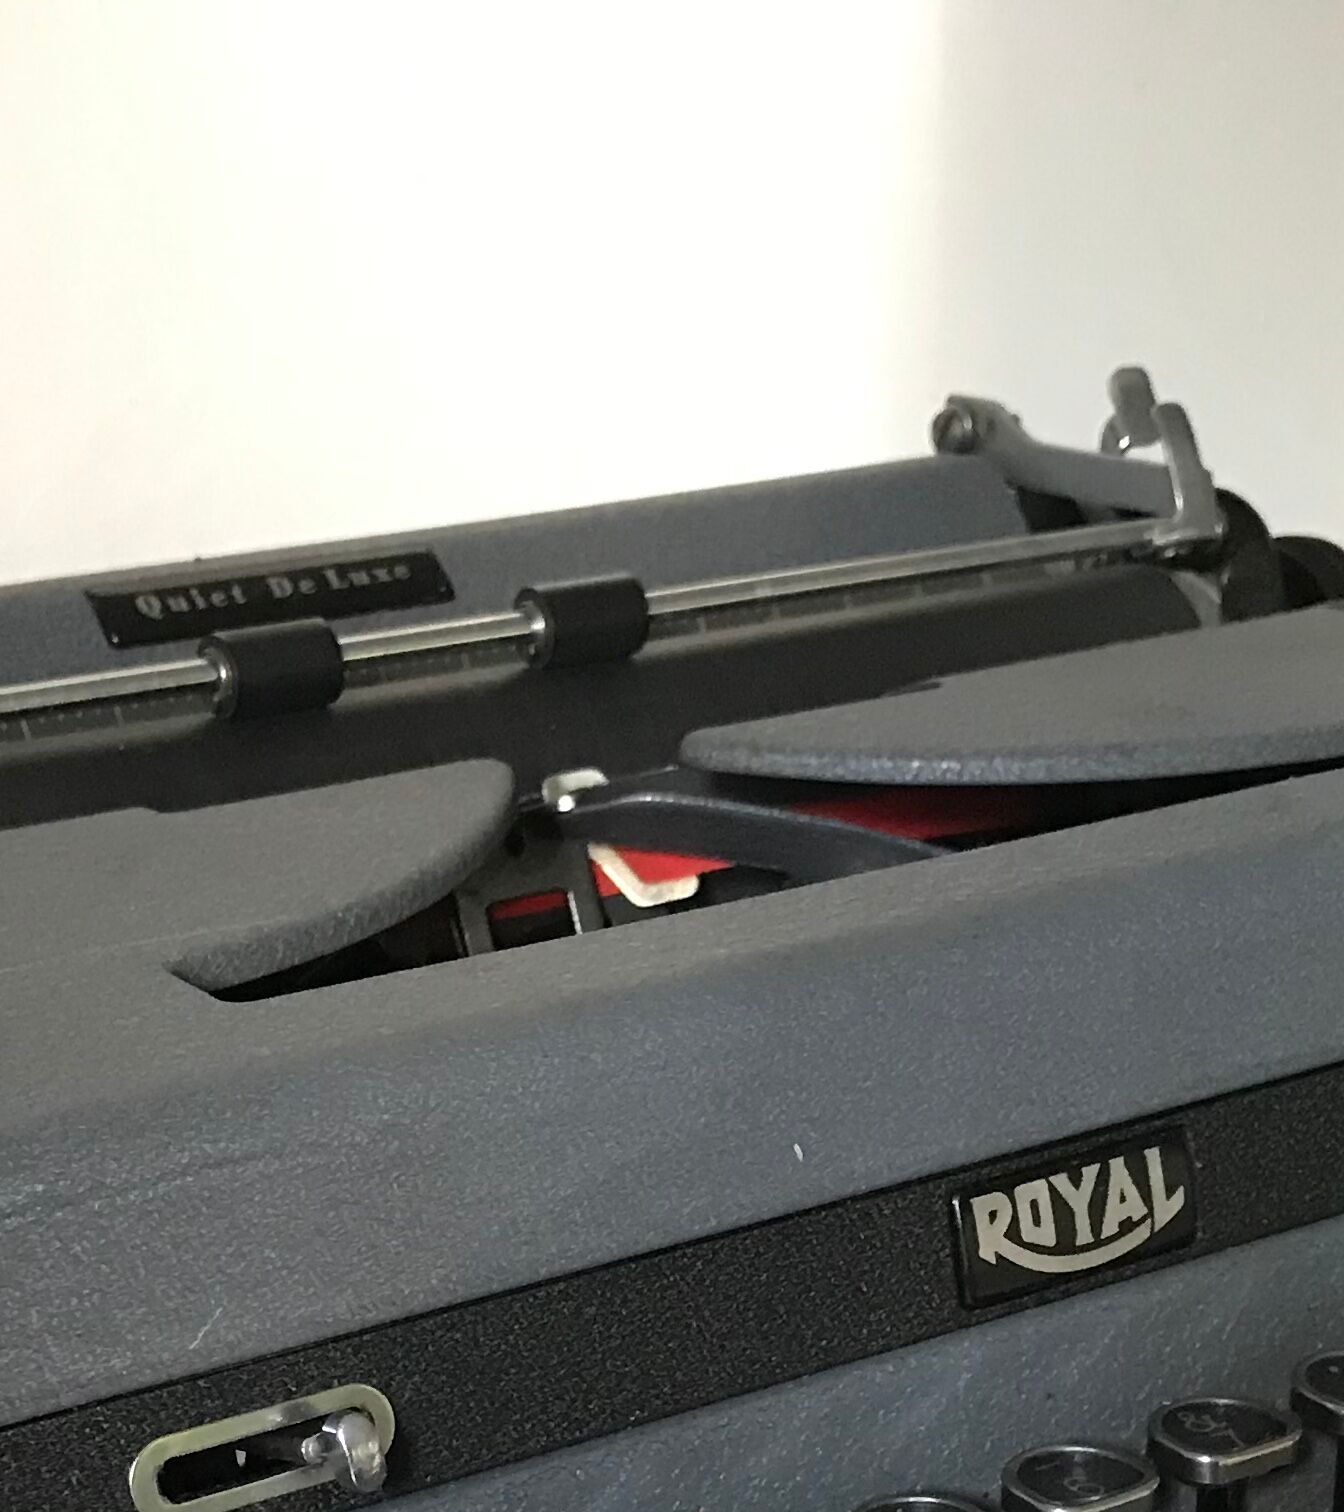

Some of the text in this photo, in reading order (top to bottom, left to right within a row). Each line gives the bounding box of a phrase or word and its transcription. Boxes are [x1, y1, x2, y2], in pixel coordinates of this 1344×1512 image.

[135, 562, 412, 621] Quiet De Luxe
[970, 1146, 1185, 1273] ROYAL
